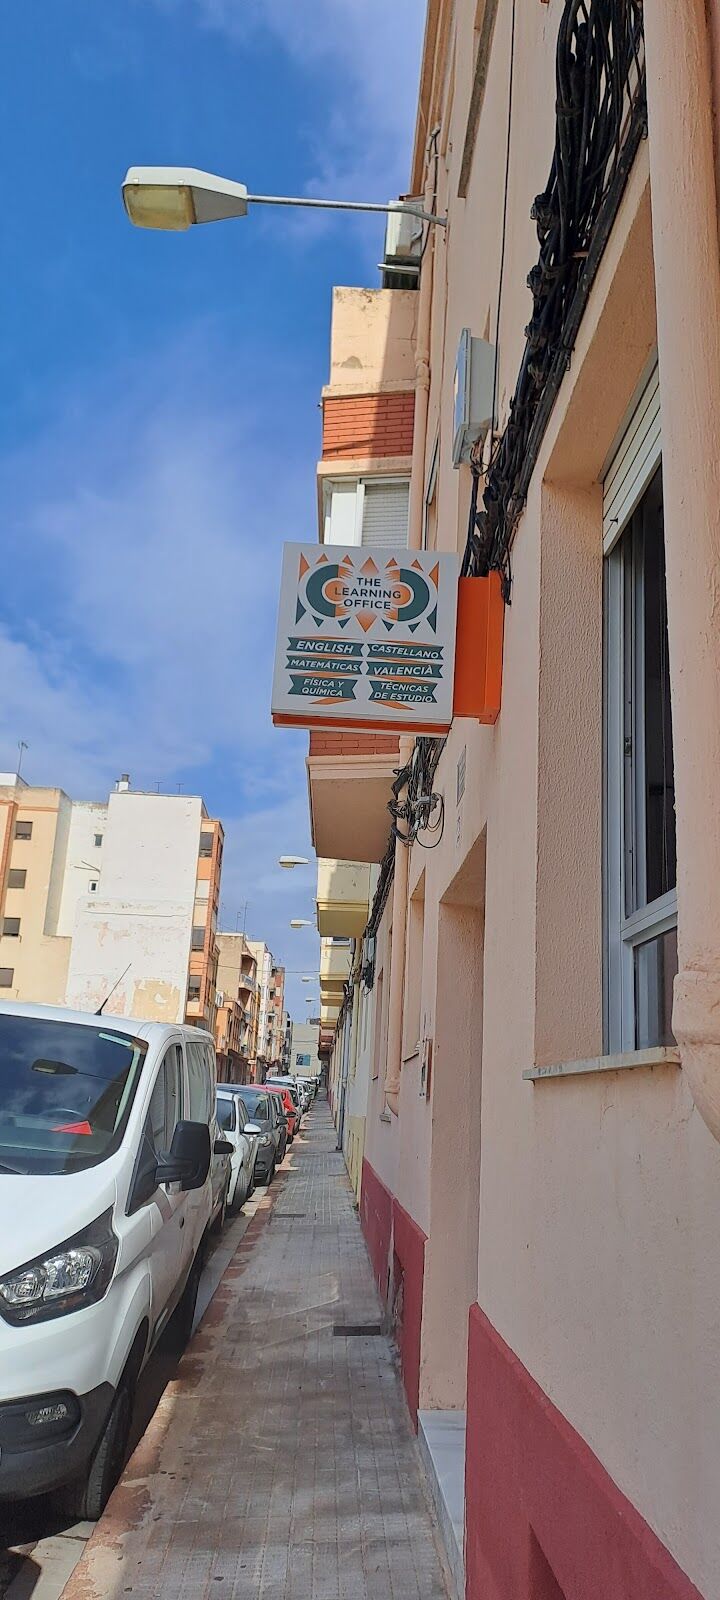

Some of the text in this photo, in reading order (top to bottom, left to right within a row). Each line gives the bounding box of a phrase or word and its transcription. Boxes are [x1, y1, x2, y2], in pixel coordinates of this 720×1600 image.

[356, 577, 381, 587] THE
[334, 587, 402, 599] LEARNING
[343, 599, 391, 609] OFFICE
[296, 641, 354, 654] ENGLISH
[371, 645, 439, 659] CASTELLANO
[290, 660, 359, 671] MATEMÁTICAS
[373, 665, 433, 675] VALENCIÀ
[303, 678, 335, 687] FÍSICA
[380, 682, 429, 693] TÉCNICAS
[301, 687, 343, 697] QUÍMICA
[390, 693, 433, 703] ESTUDIO
